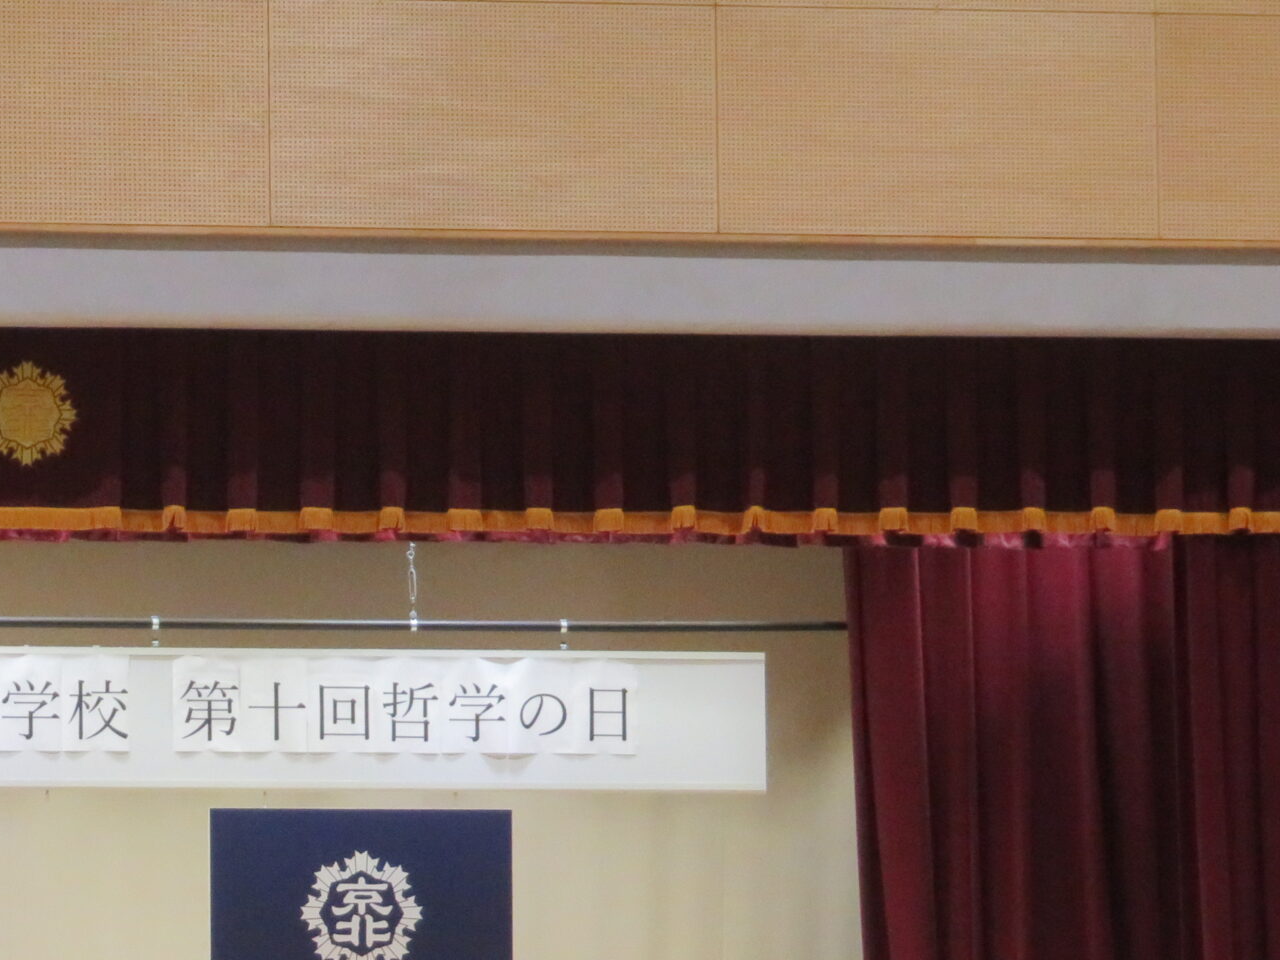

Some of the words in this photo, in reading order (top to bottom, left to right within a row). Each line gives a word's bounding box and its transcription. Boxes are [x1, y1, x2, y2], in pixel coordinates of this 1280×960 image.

[180, 679, 629, 742] 第十回哲学の日
[331, 876, 394, 947] 京北
